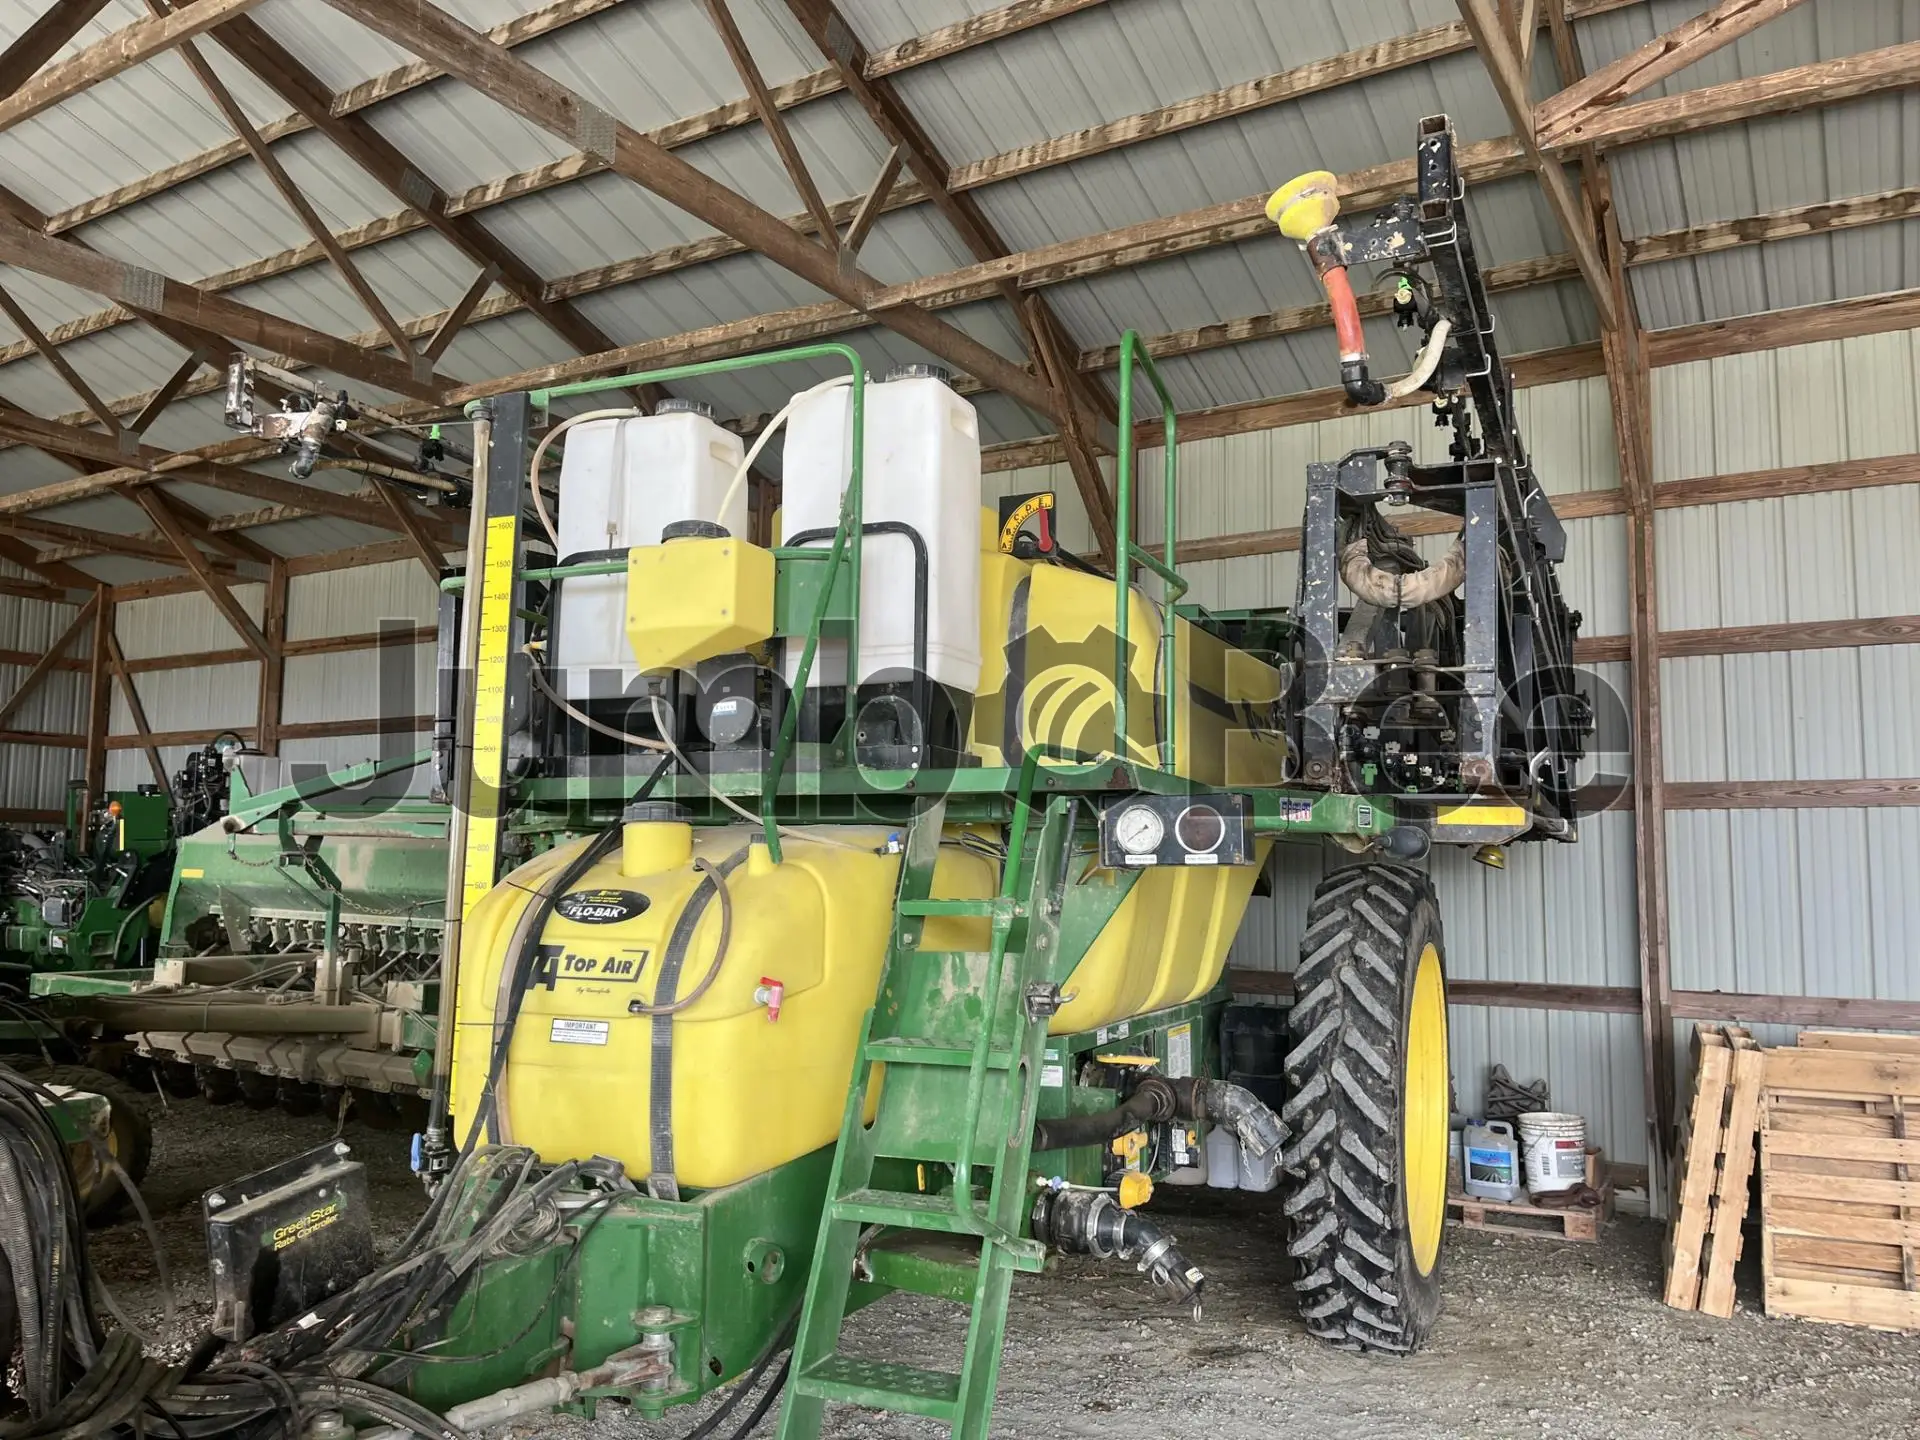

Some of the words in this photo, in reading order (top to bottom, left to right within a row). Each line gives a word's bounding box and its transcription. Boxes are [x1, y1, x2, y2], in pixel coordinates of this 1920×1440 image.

[498, 522, 514, 530] 1600
[496, 560, 512, 568] 1500
[491, 625, 507, 633] 1300
[489, 656, 504, 664] 1200
[483, 745, 496, 753] 900
[568, 906, 620, 918] FLO-BAK
[564, 1021, 597, 1030] IMPORTANT
[273, 1203, 338, 1241] GreenStar
[273, 1235, 296, 1250] Rate
[296, 1213, 338, 1239] Controller
